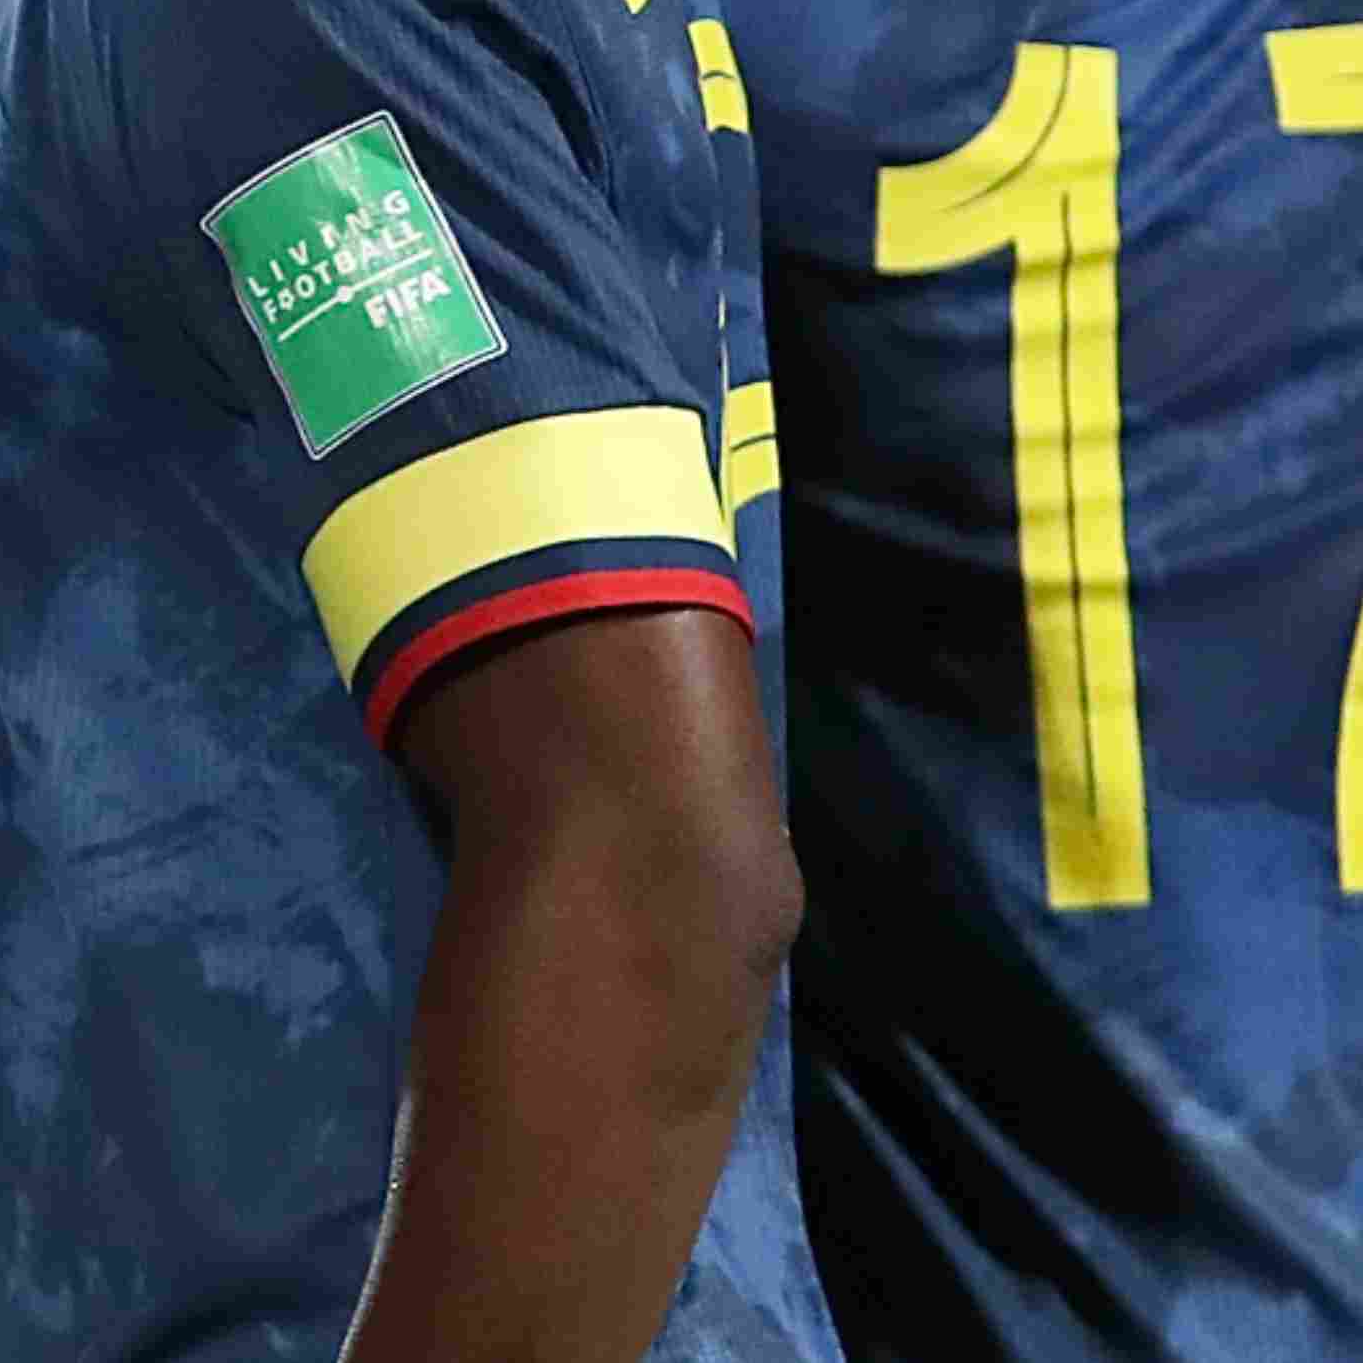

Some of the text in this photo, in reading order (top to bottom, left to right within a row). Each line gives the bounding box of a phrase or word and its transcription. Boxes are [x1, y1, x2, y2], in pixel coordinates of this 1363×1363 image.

[247, 189, 411, 298] LIVING
[263, 221, 425, 323] FOOTBALL
[363, 265, 452, 329] FIFA
